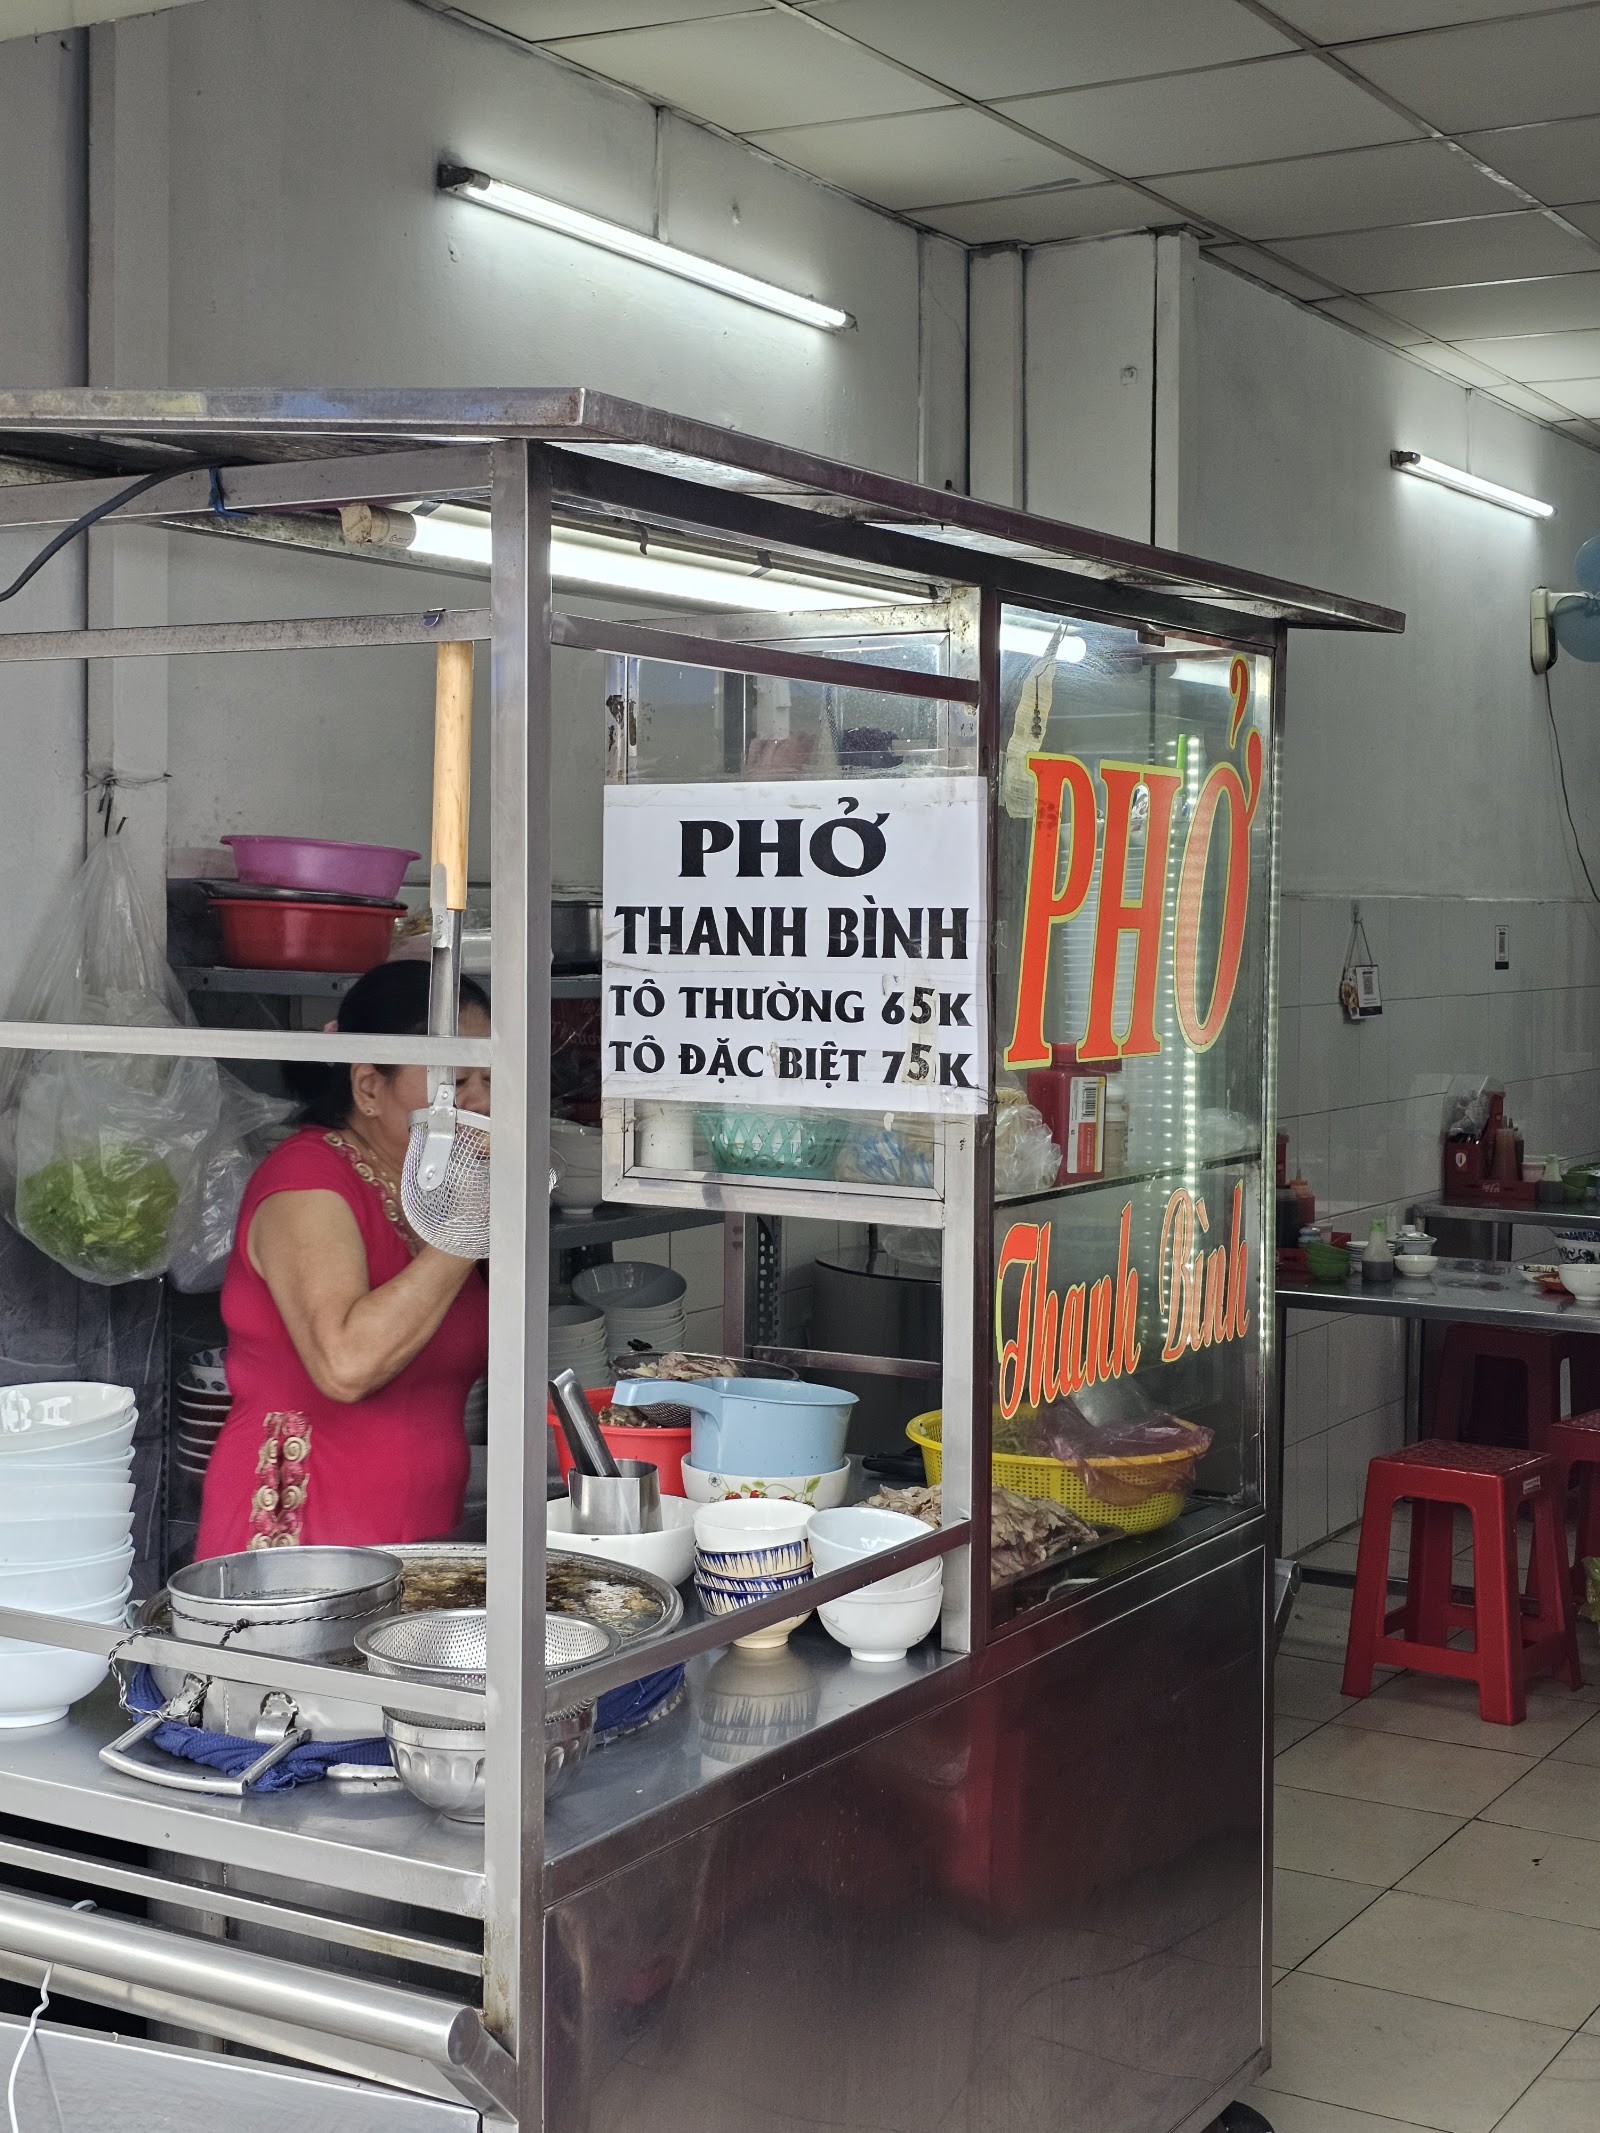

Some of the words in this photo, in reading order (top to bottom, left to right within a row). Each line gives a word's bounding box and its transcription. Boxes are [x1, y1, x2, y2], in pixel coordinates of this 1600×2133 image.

[678, 796, 890, 878] PHỞ
[1003, 653, 1262, 1071] PHỞ
[614, 906, 807, 958] THANH
[827, 894, 970, 960] BÌNH
[608, 978, 665, 1018] TÔ
[678, 980, 865, 1024] THƯỜNG
[881, 986, 973, 1027] 65K
[608, 1034, 665, 1074] TÔ
[678, 1037, 764, 1084] ĐẶC
[779, 1040, 867, 1089] BIỆT
[881, 1043, 974, 1088] 75K
[995, 1200, 1142, 1420] Thanh
[1158, 1178, 1250, 1362] Bình
